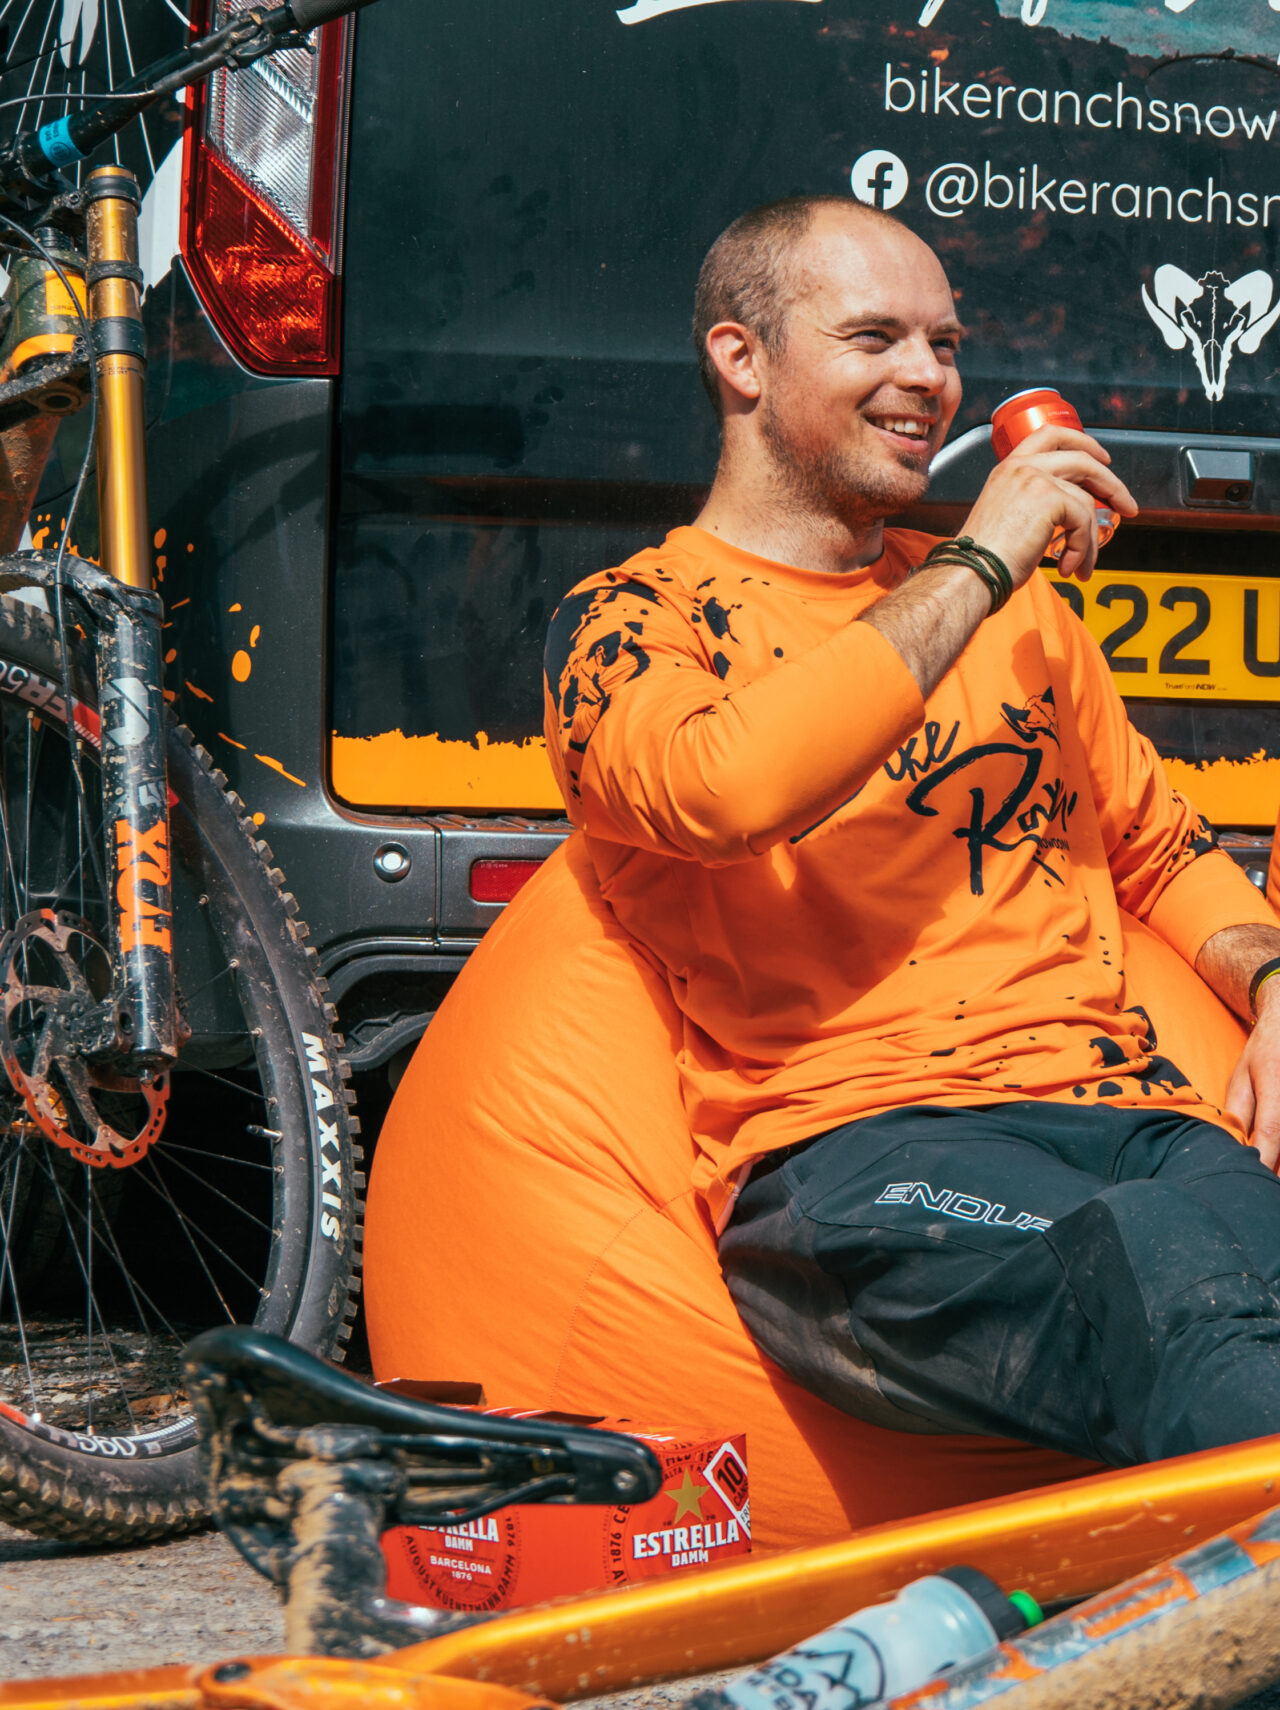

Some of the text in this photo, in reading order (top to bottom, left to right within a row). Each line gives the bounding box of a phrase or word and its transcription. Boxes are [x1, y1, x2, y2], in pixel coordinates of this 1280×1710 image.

[115, 818, 173, 955] FOX
[301, 1031, 342, 1241] MAXXIS
[717, 1456, 744, 1495] 10
[444, 1535, 474, 1552] DAMM
[632, 1518, 740, 1560] ESTRELLA
[671, 1549, 709, 1568] DAMM
[404, 1535, 437, 1591] AUGUST
[497, 1554, 516, 1597] DAMM
[429, 1555, 492, 1575] BARCELONA
